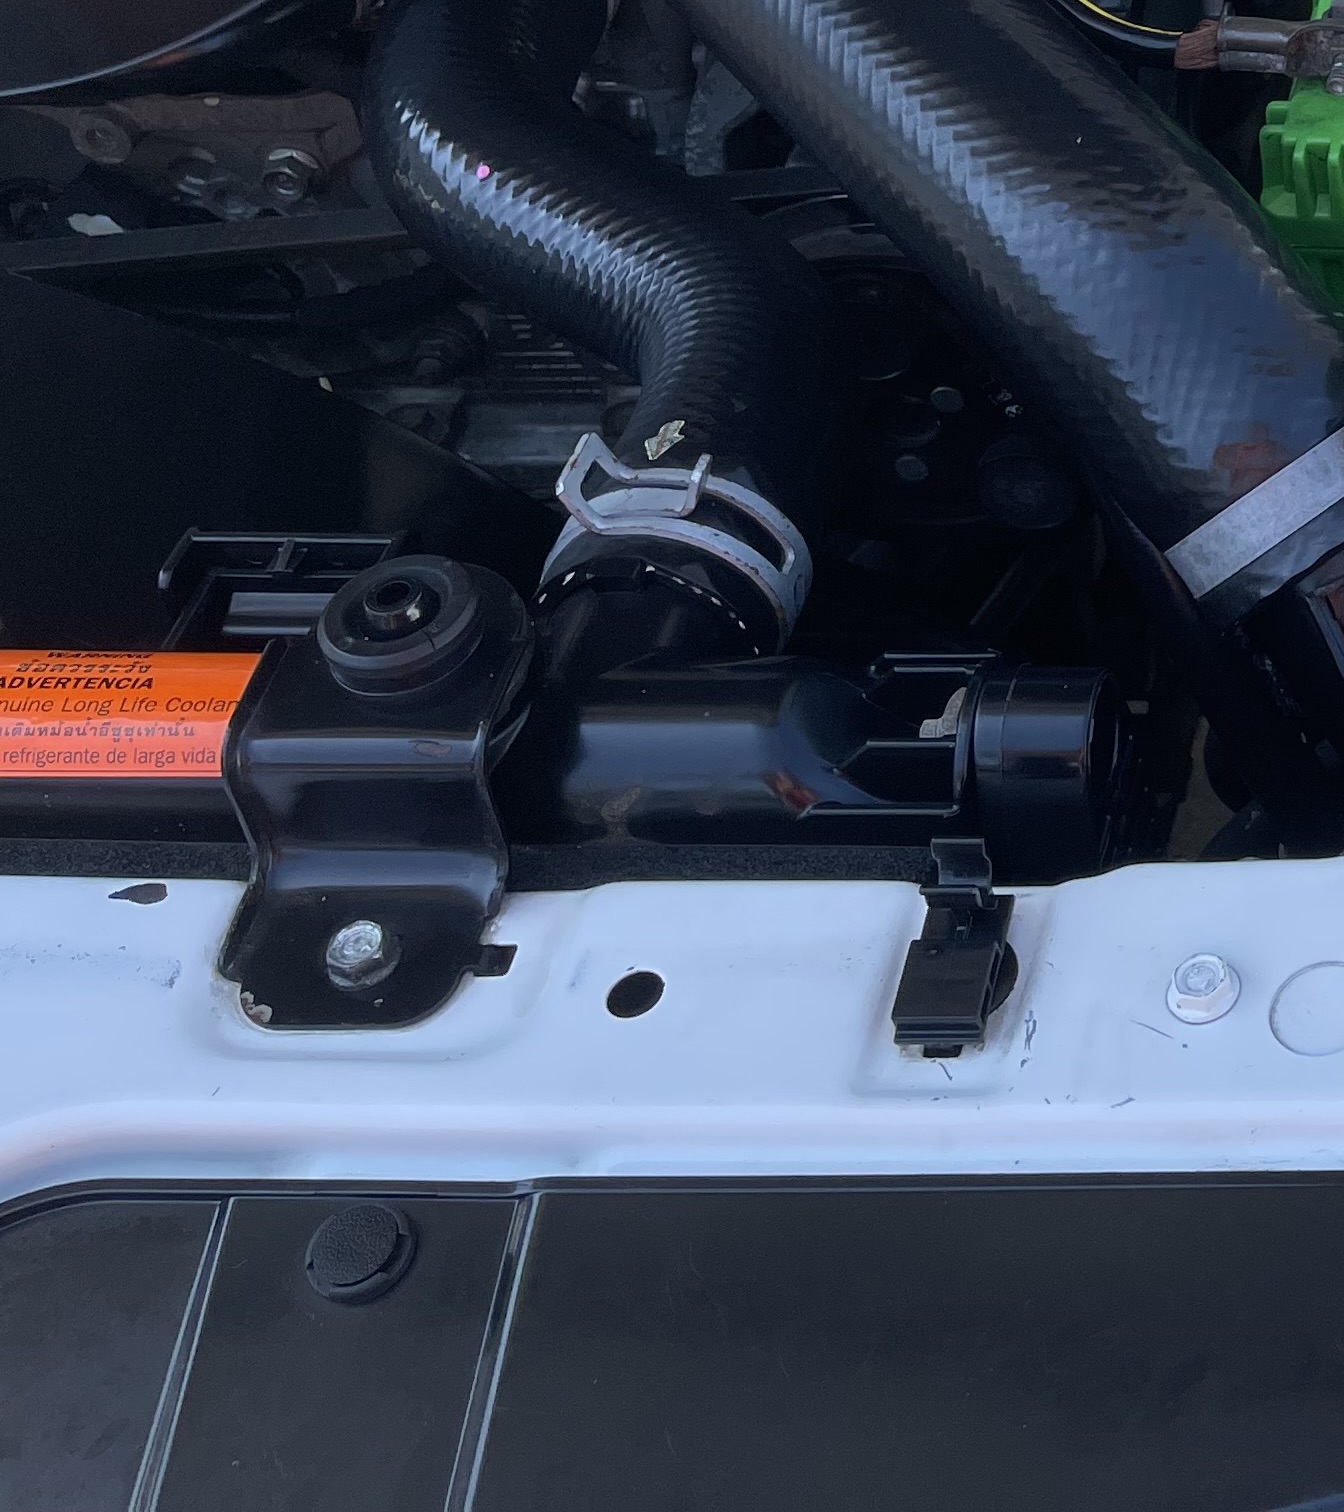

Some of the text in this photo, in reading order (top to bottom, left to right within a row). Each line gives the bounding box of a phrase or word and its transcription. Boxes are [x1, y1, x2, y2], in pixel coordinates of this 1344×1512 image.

[61, 696, 113, 717] Long
[119, 696, 158, 713] Life
[3, 746, 217, 768] refrigerante de larga vida
